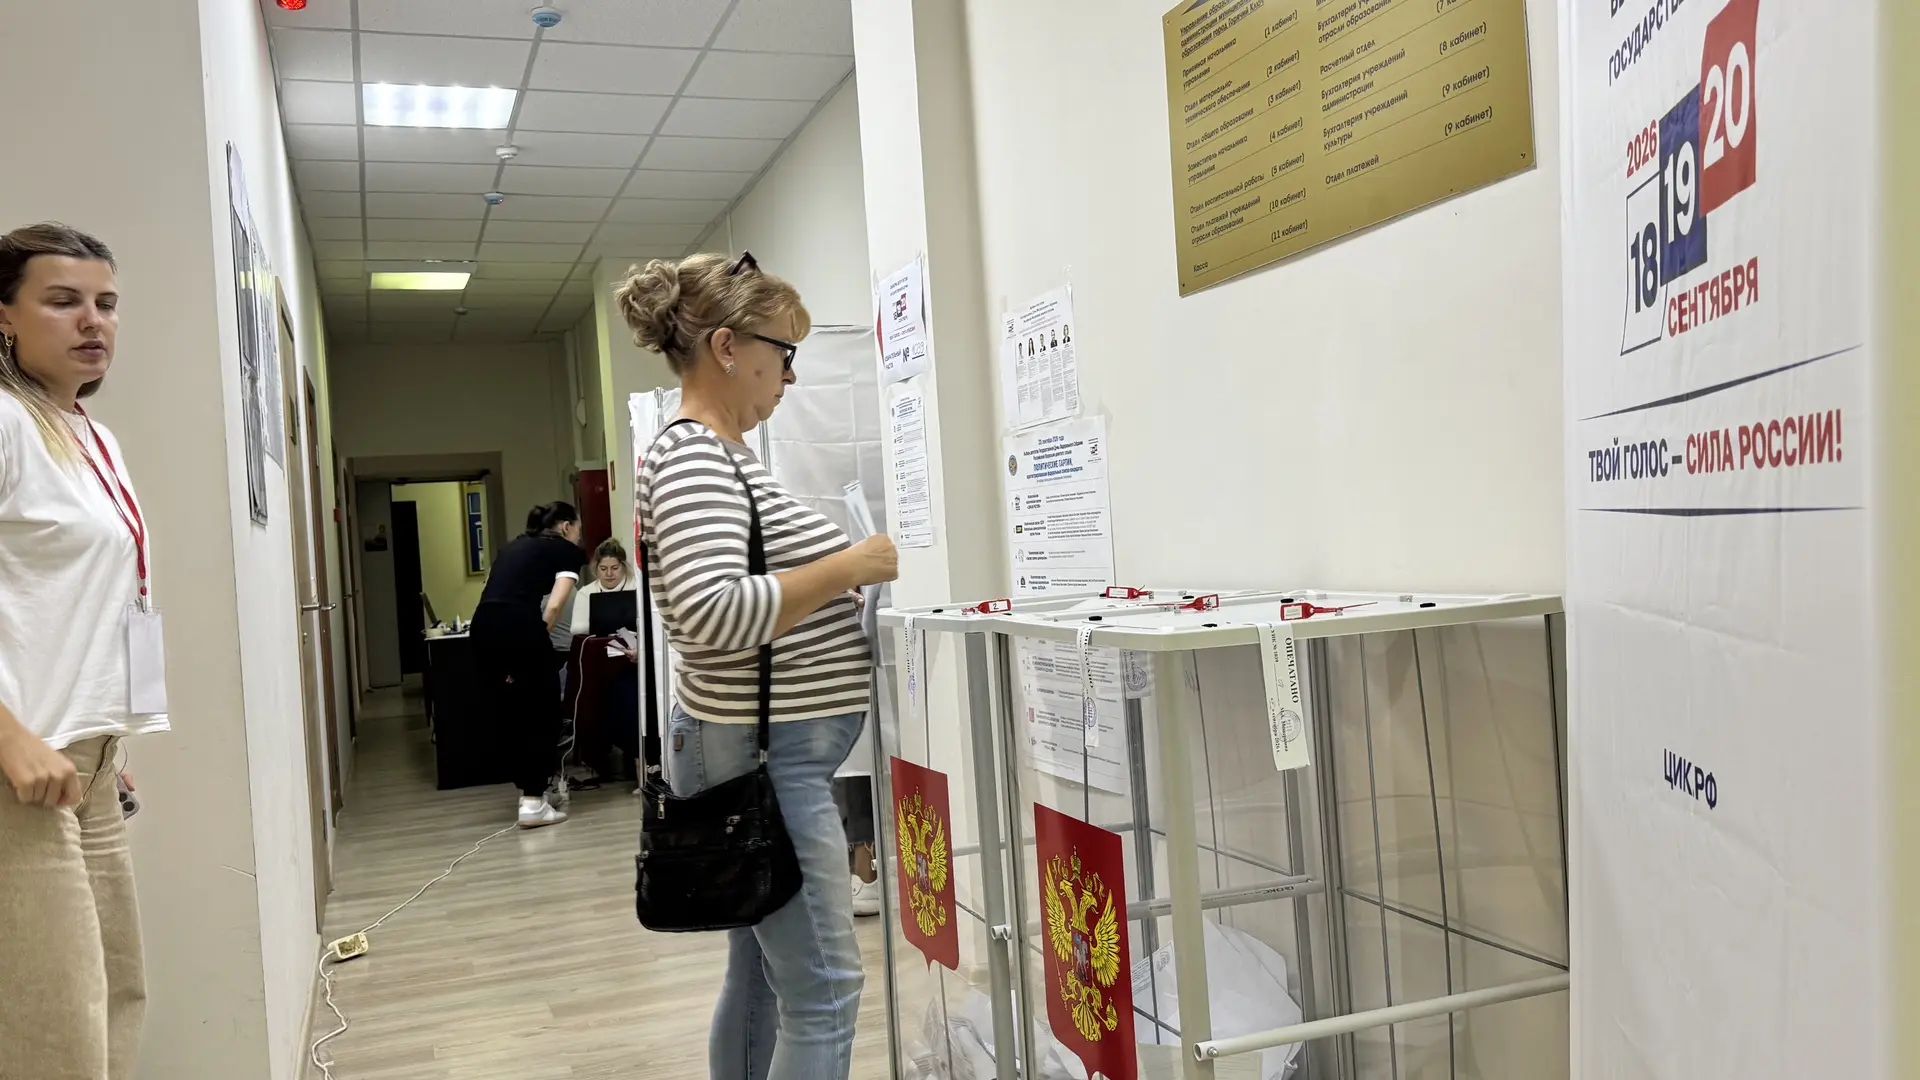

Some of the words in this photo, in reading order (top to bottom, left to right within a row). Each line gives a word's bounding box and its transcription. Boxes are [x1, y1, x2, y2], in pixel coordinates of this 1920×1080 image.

[1264, 26, 1271, 38] (1
[1271, 10, 1298, 34] кабинет)
[1317, 2, 1357, 31] Бухгалтерия
[1318, 23, 1345, 43] отрасли
[1439, 41, 1448, 55] (8
[1449, 21, 1487, 48] кабинет)
[1609, 0, 1684, 86] ГОСУДАРСТ
[1266, 64, 1274, 77] (2
[1274, 50, 1300, 72] кабинет)
[1320, 49, 1355, 75] Расчетный
[1356, 39, 1376, 55] отдел
[1321, 72, 1361, 100] Бухгалтерия
[1362, 49, 1406, 80] учреждений
[1442, 83, 1451, 97] (9
[1452, 65, 1490, 93] кабинет)
[1267, 94, 1274, 107] (3
[1274, 80, 1301, 102] кабинет)
[1321, 80, 1374, 112] администрации
[1702, 41, 1751, 171] 20
[1269, 130, 1276, 143] (4
[1276, 117, 1303, 140] кабинет)
[1323, 111, 1363, 138] Бухгалтерия
[1364, 90, 1408, 121] учреждений
[1444, 121, 1453, 136] (9
[1454, 105, 1493, 131] кабинет)
[1323, 131, 1353, 151] культуры
[1626, 118, 1658, 179] 2026
[1271, 164, 1278, 177] (5
[1278, 152, 1305, 173] кабинет)
[1325, 169, 1345, 185] Отдел
[1346, 154, 1380, 177] платежей
[1269, 199, 1279, 213] (10
[1279, 188, 1306, 207] кабинет)
[1664, 140, 1696, 245] 19
[1271, 229, 1281, 243] (11
[1281, 219, 1308, 239] кабинет)
[1631, 221, 1658, 314] 18
[1667, 256, 1760, 339] СЕНТЯБРЯ
[1588, 437, 1620, 483] ТВОЙ
[1623, 438, 1668, 481] ГОЛОС
[1686, 428, 1735, 475] СИЛА
[1738, 409, 1842, 471] РОССИИ!
[992, 602, 1000, 610] 2
[1285, 637, 1299, 704] ОПЕЧАТАНО
